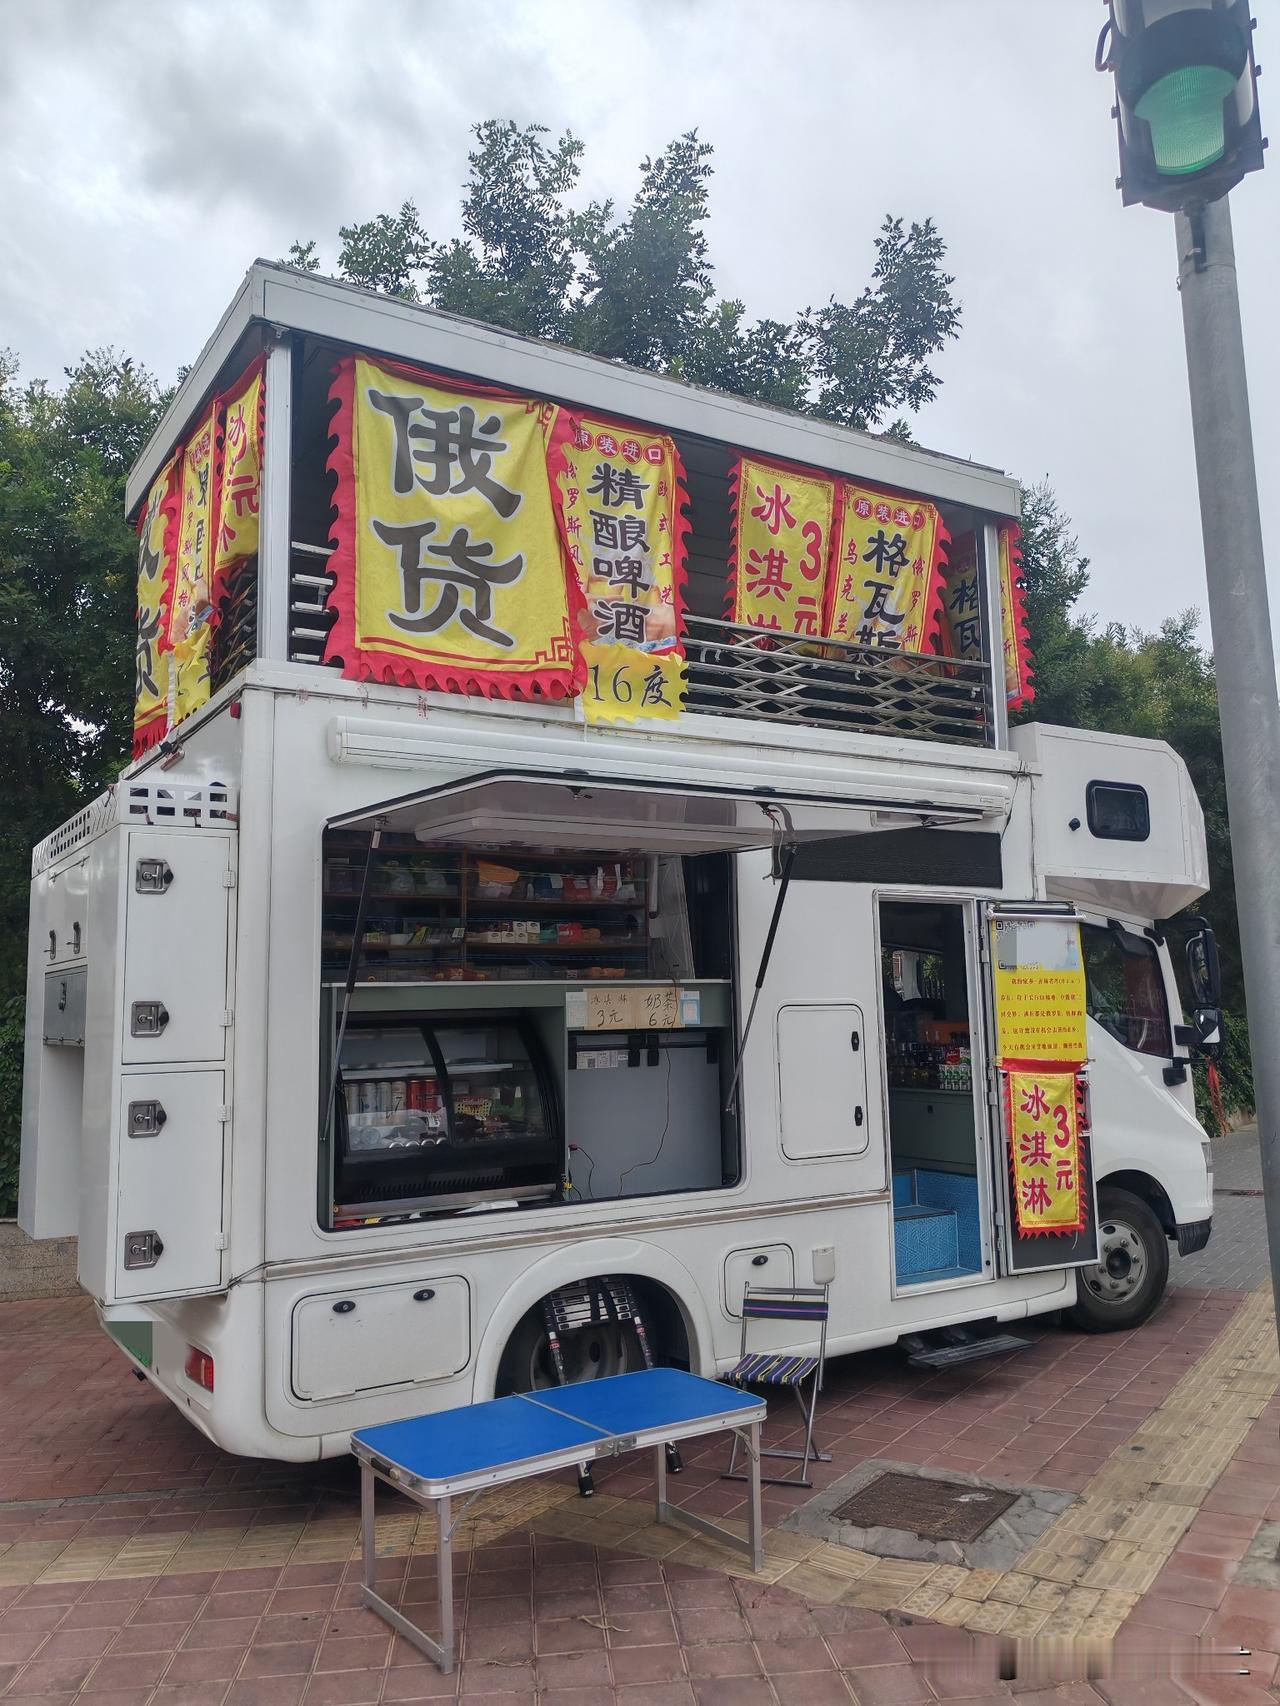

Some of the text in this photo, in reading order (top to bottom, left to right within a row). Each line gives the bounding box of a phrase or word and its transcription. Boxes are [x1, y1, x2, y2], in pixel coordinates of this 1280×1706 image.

[575, 428, 662, 461] 原装进口
[368, 388, 521, 647] 俄货
[587, 462, 651, 644] 精酿啤酒
[855, 498, 923, 527] 原装进口
[794, 519, 823, 636] 3元
[833, 538, 858, 635] 乌克兰
[903, 556, 925, 644] 俄罗斯
[588, 663, 673, 707] 16度
[597, 1009, 624, 1027] 3元
[645, 990, 675, 1012] 奶茶
[648, 1012, 674, 1027] 6元
[1020, 1084, 1053, 1216] 冰淇淋
[1053, 1104, 1074, 1191] 3元
